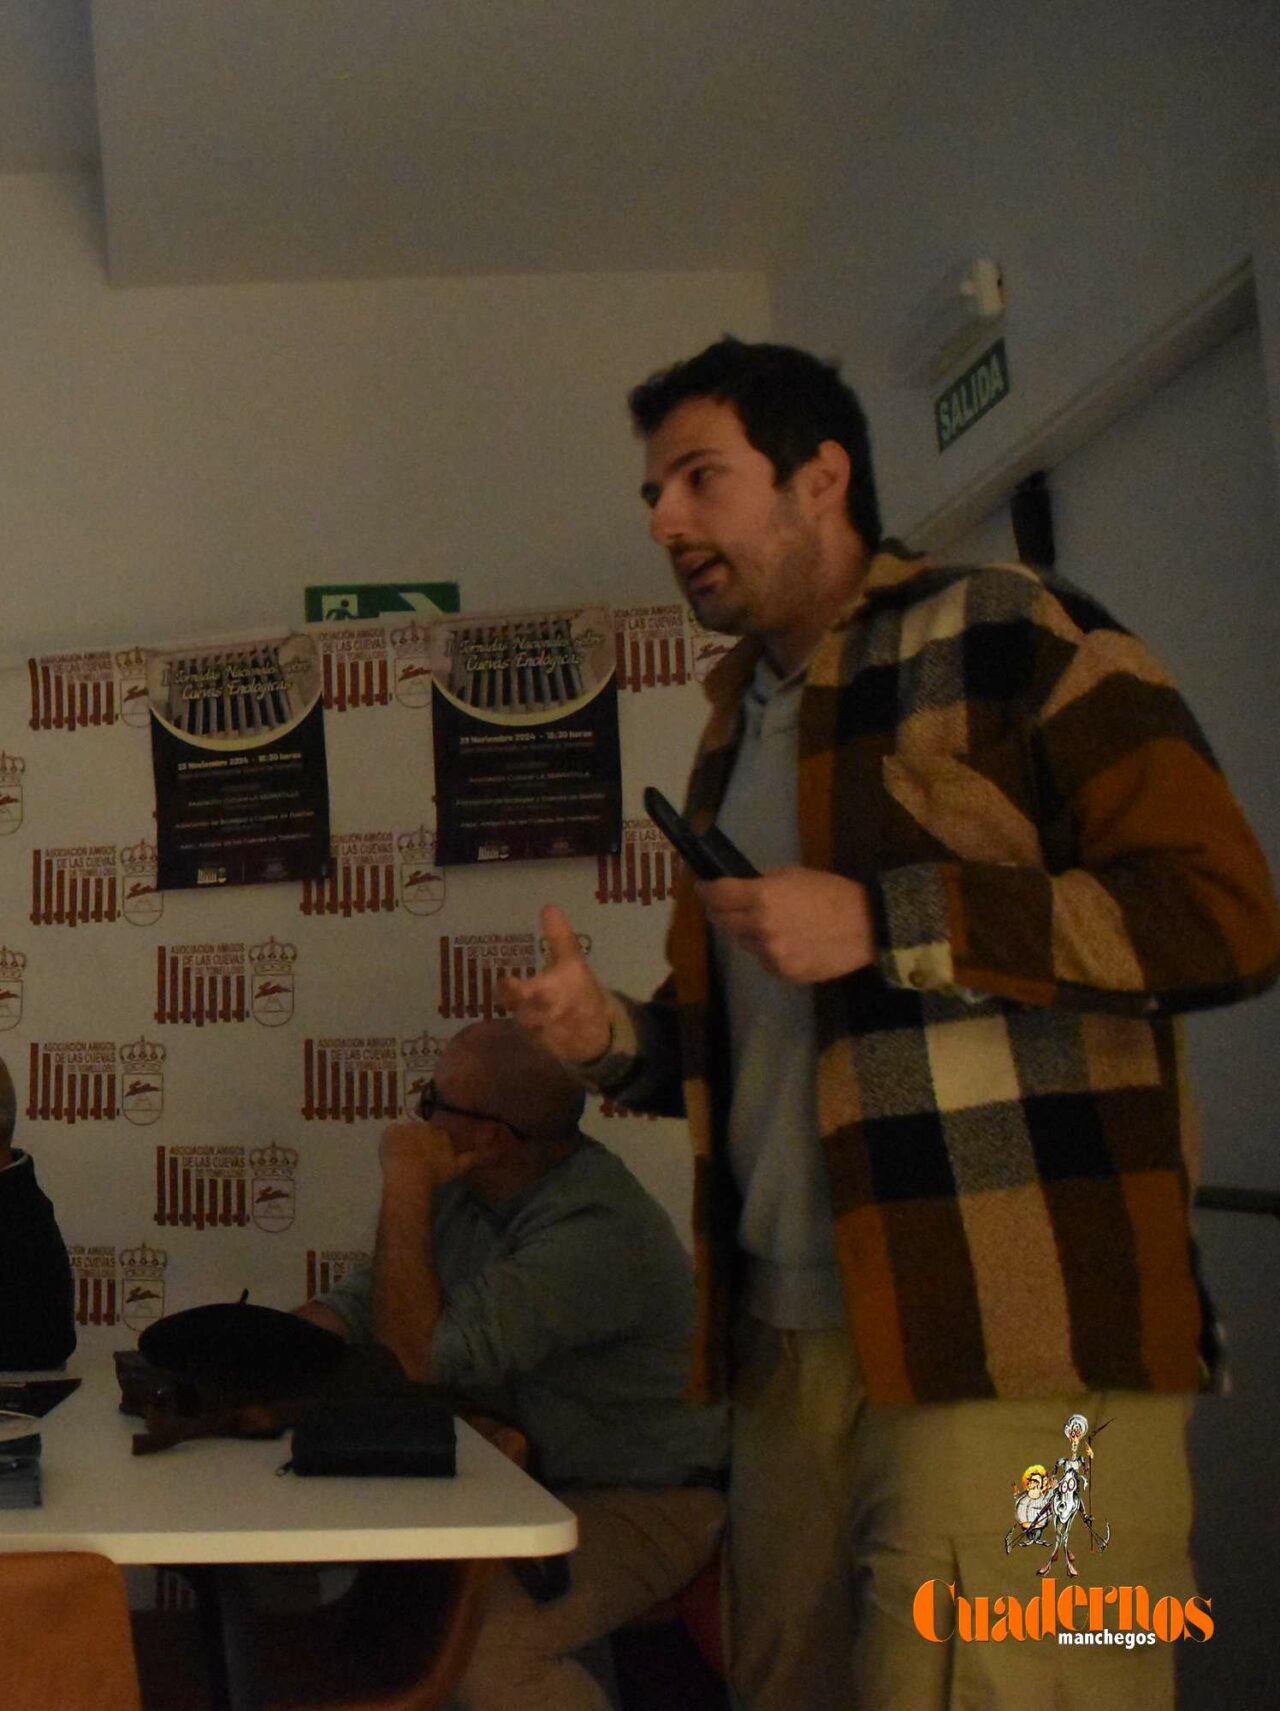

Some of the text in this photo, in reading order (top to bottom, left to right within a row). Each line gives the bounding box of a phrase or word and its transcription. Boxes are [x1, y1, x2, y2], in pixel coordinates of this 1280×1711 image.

[939, 352, 1004, 441] SALIDA
[66, 1052, 83, 1064] LAS
[84, 1052, 116, 1063] CUEVAS
